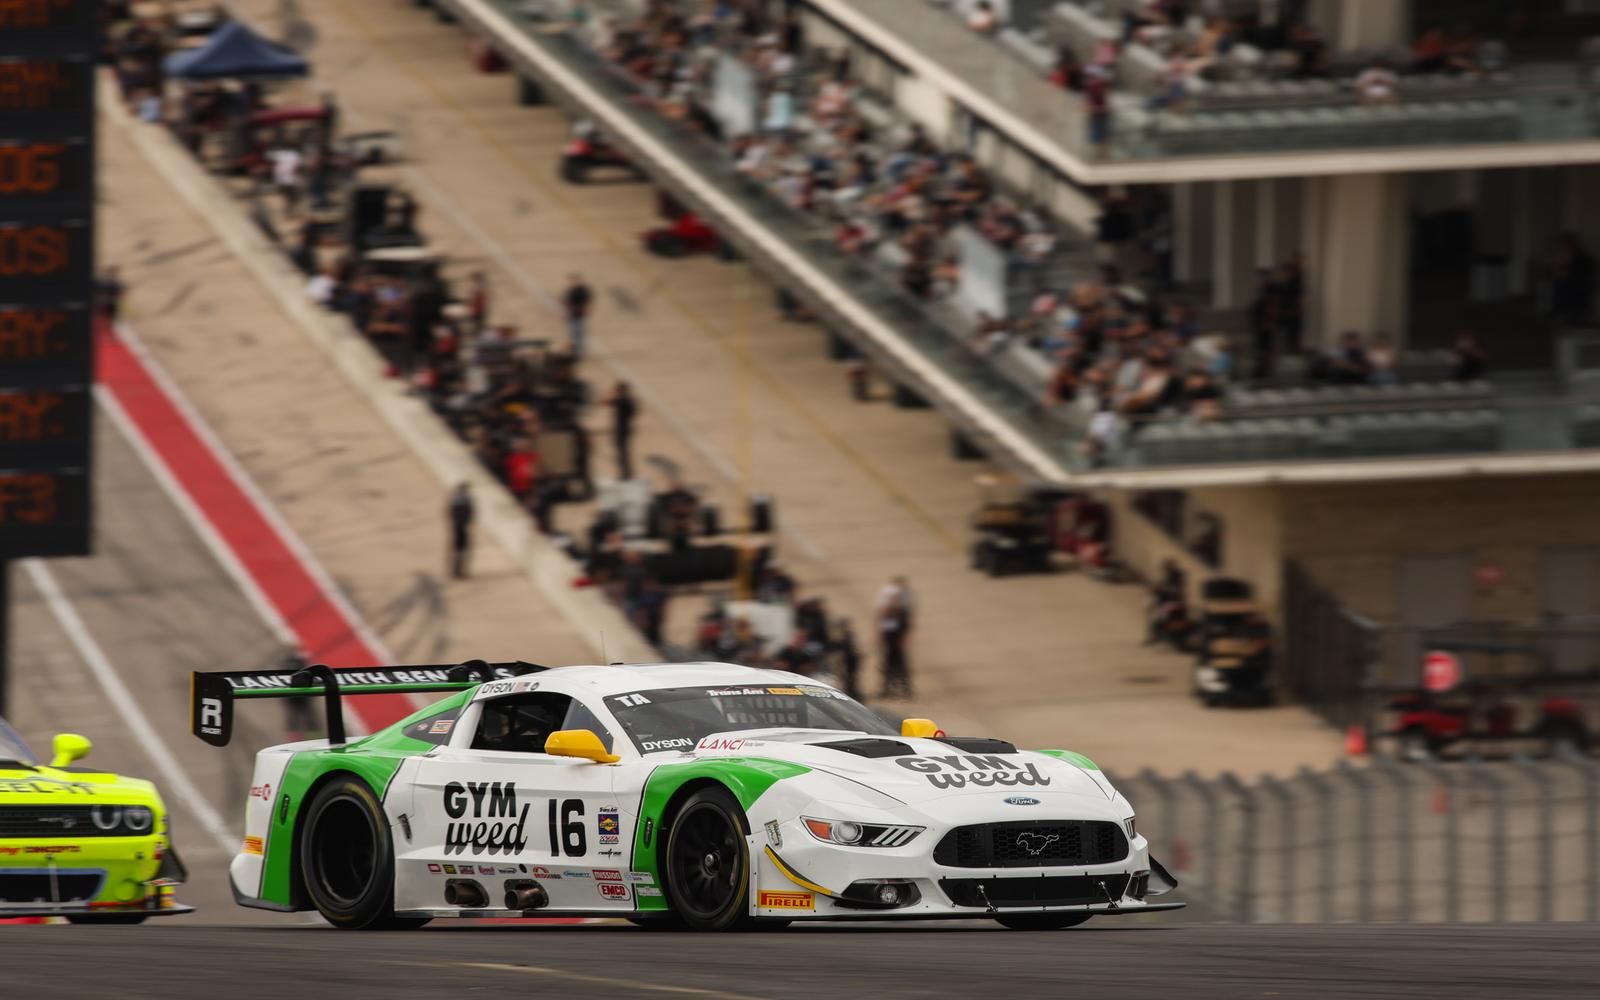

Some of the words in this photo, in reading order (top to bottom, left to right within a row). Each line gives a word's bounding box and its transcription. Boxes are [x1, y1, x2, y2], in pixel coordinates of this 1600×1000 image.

[482, 682, 514, 694] DYSON
[706, 689, 742, 697] Trans
[614, 693, 652, 707] TA
[202, 698, 222, 726] R
[641, 737, 694, 751] DYSON
[699, 738, 746, 751] LANCI
[895, 755, 1020, 773] GYM
[926, 762, 1050, 789] weed
[443, 781, 517, 819] GYM
[1010, 797, 1034, 805] Ford
[444, 803, 531, 856] weed
[548, 799, 587, 857] 16
[602, 885, 626, 896] EMCO
[761, 892, 811, 907] PIRELLI
